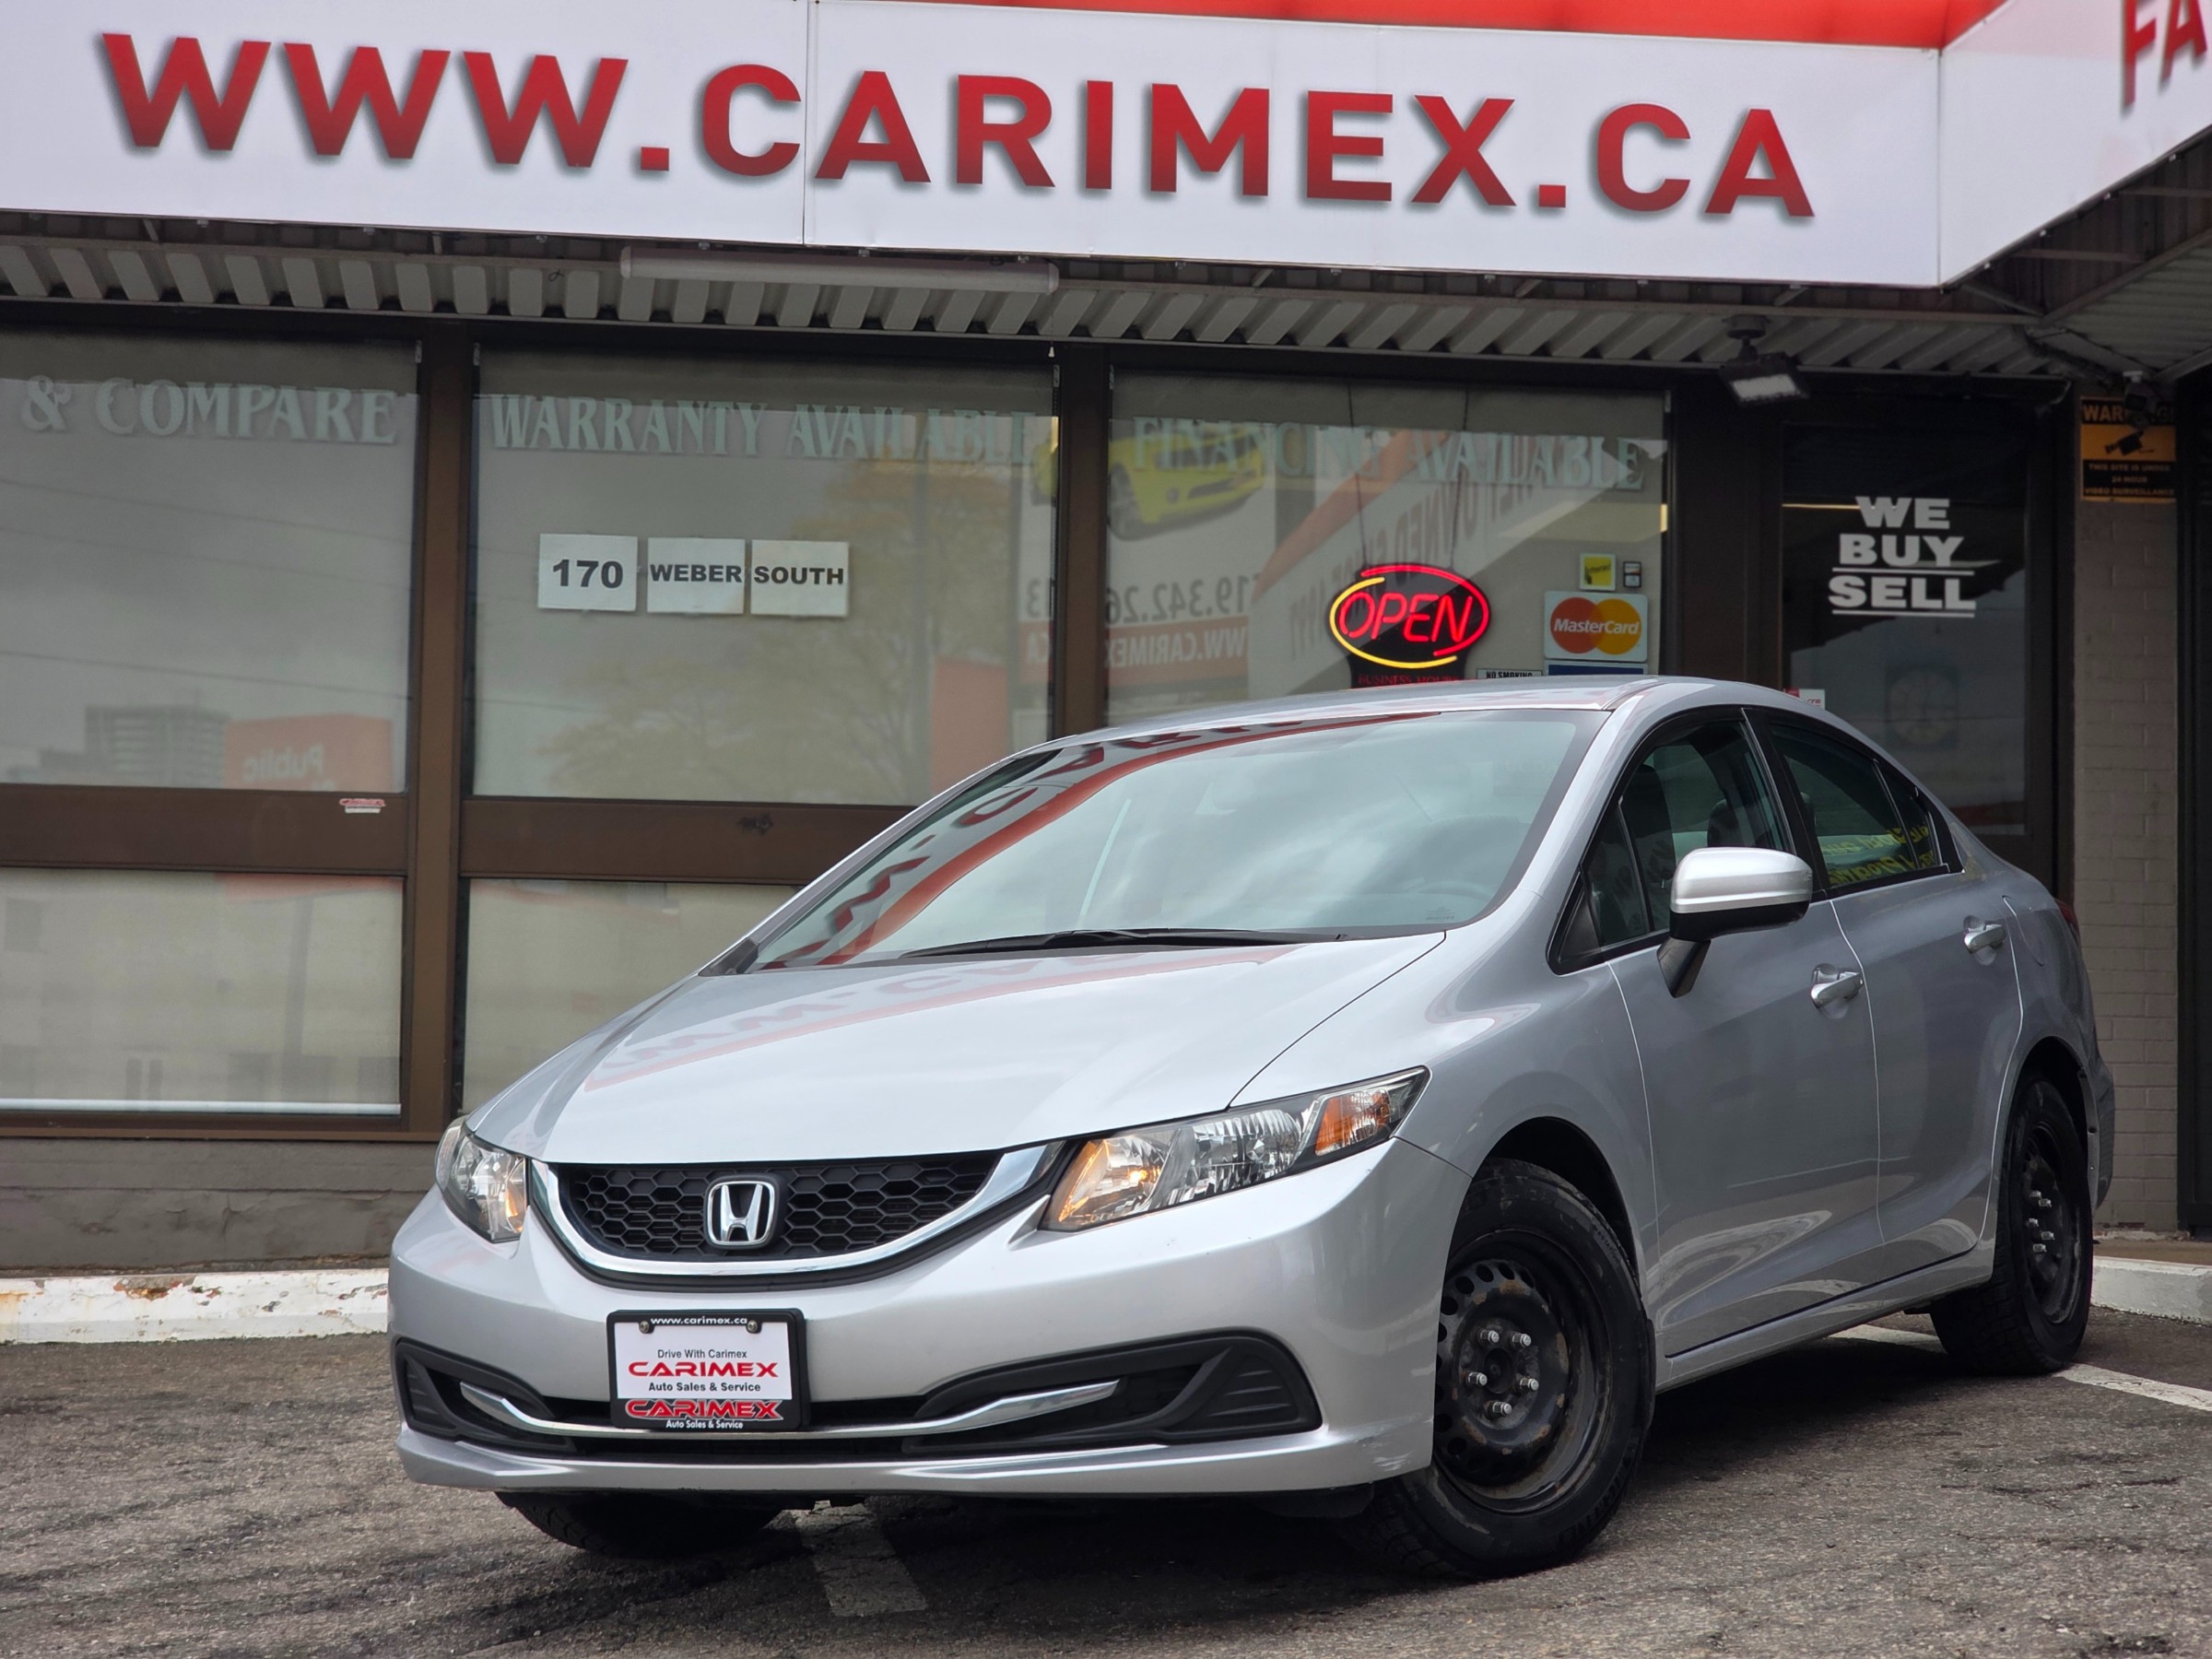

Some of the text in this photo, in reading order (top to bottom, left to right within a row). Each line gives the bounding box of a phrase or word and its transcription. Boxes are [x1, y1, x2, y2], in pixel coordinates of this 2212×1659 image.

[101, 32, 1815, 218] WWW.CARIMEX.CA
[20, 374, 396, 444] & COMPARE
[488, 394, 1037, 463] WARRANTY AVAILABLE
[1401, 428, 1644, 490] AVAILABLE
[1854, 496, 1950, 530] WE
[1839, 533, 1965, 568] BUY
[552, 559, 844, 589] 170 WEBER SOUTH
[1828, 574, 1977, 610] SELL
[1337, 591, 1474, 643] OPEN
[1553, 618, 1641, 635] MasterCard
[650, 1315, 747, 1325] www.carimex.ca
[628, 1361, 779, 1378] CARIMEX
[657, 1348, 747, 1359] Drive With Carimex
[648, 1382, 761, 1392] Auto Sales & Service
[626, 1399, 783, 1420] CARIMEX
[665, 1419, 744, 1430] Auto Sales & Service
